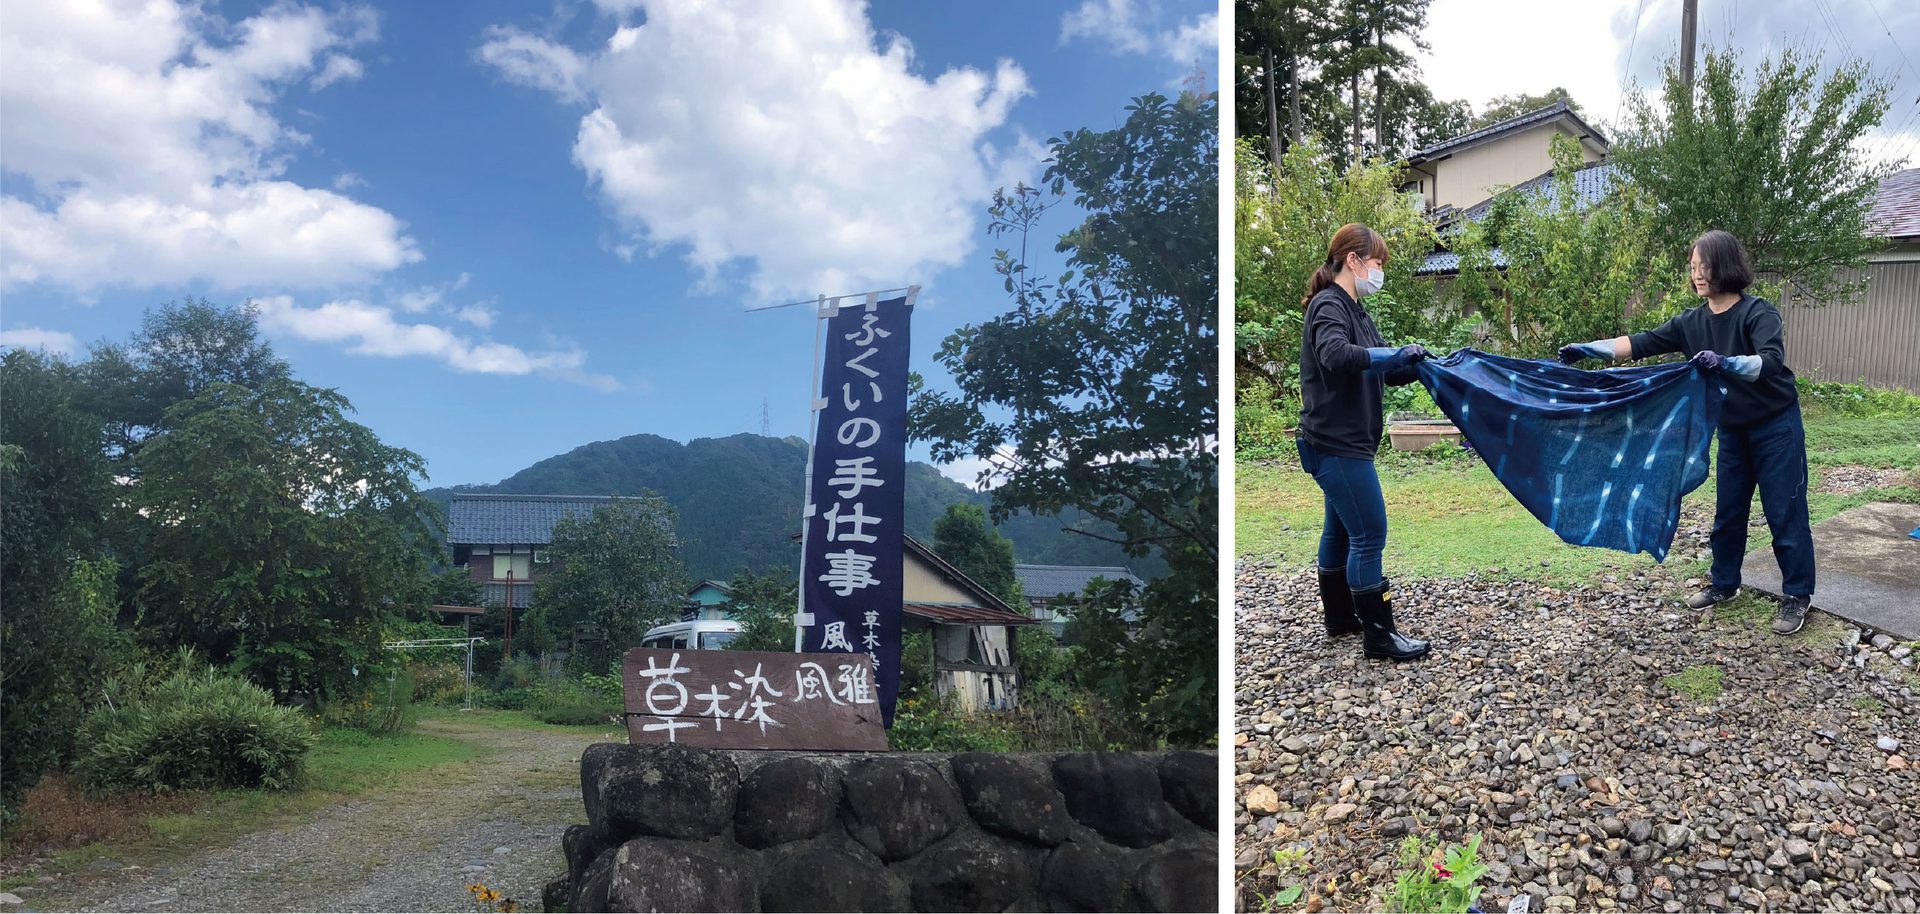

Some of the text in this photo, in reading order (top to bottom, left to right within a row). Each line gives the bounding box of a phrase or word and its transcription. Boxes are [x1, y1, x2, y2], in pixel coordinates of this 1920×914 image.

[819, 313, 892, 597] ふくいの手仕事
[820, 621, 853, 652] 風
